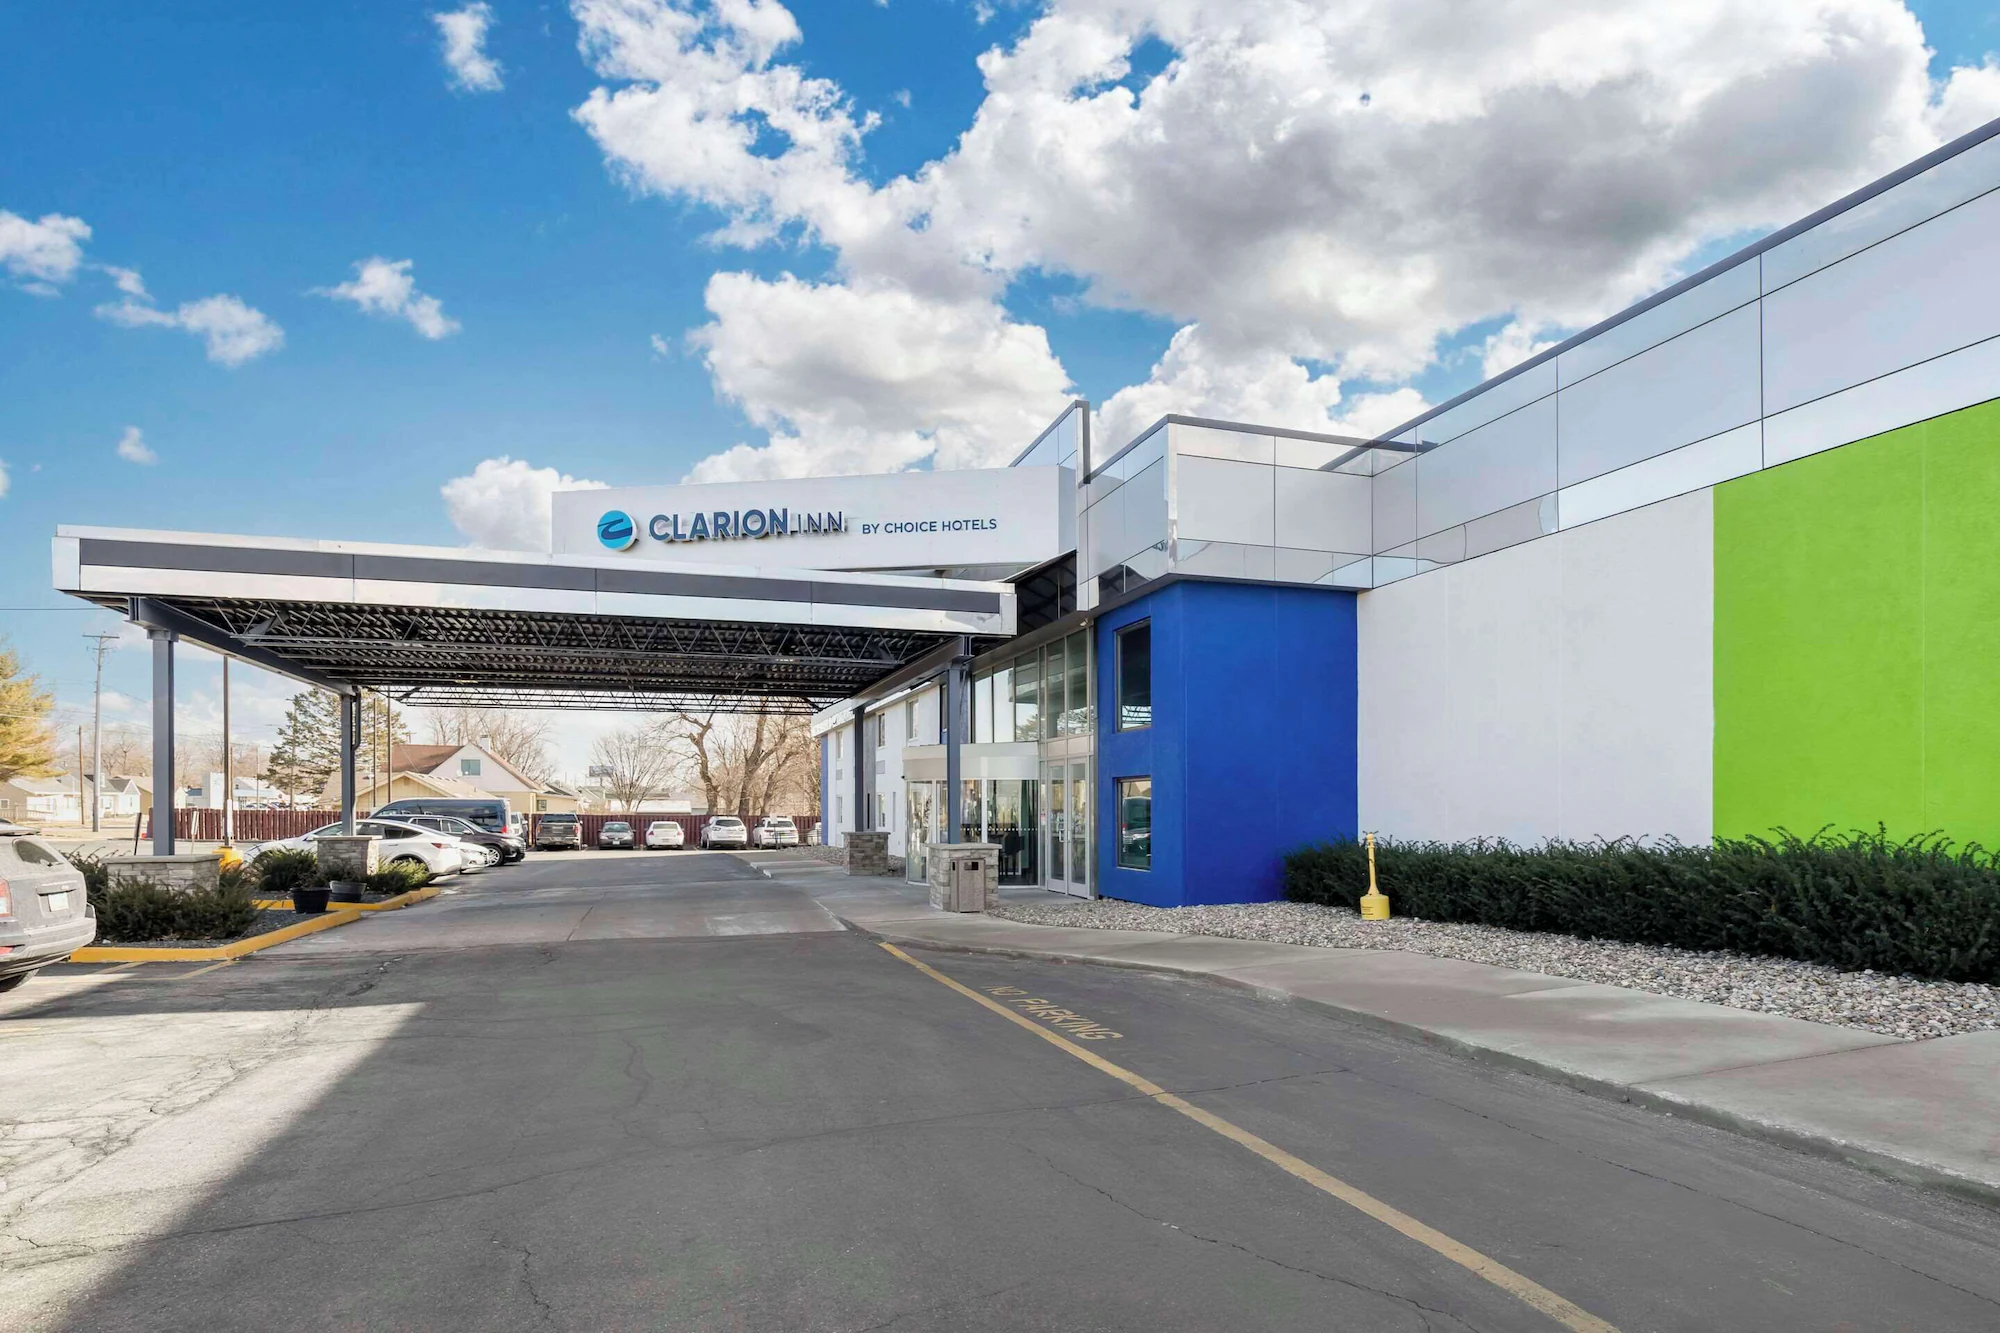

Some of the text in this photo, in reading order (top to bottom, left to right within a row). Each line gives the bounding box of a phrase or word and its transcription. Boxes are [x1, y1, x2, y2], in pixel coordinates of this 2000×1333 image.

[649, 508, 997, 541] CLARION INN BY CHOICE HOTELS
[980, 985, 1124, 1040] NO PARKING
